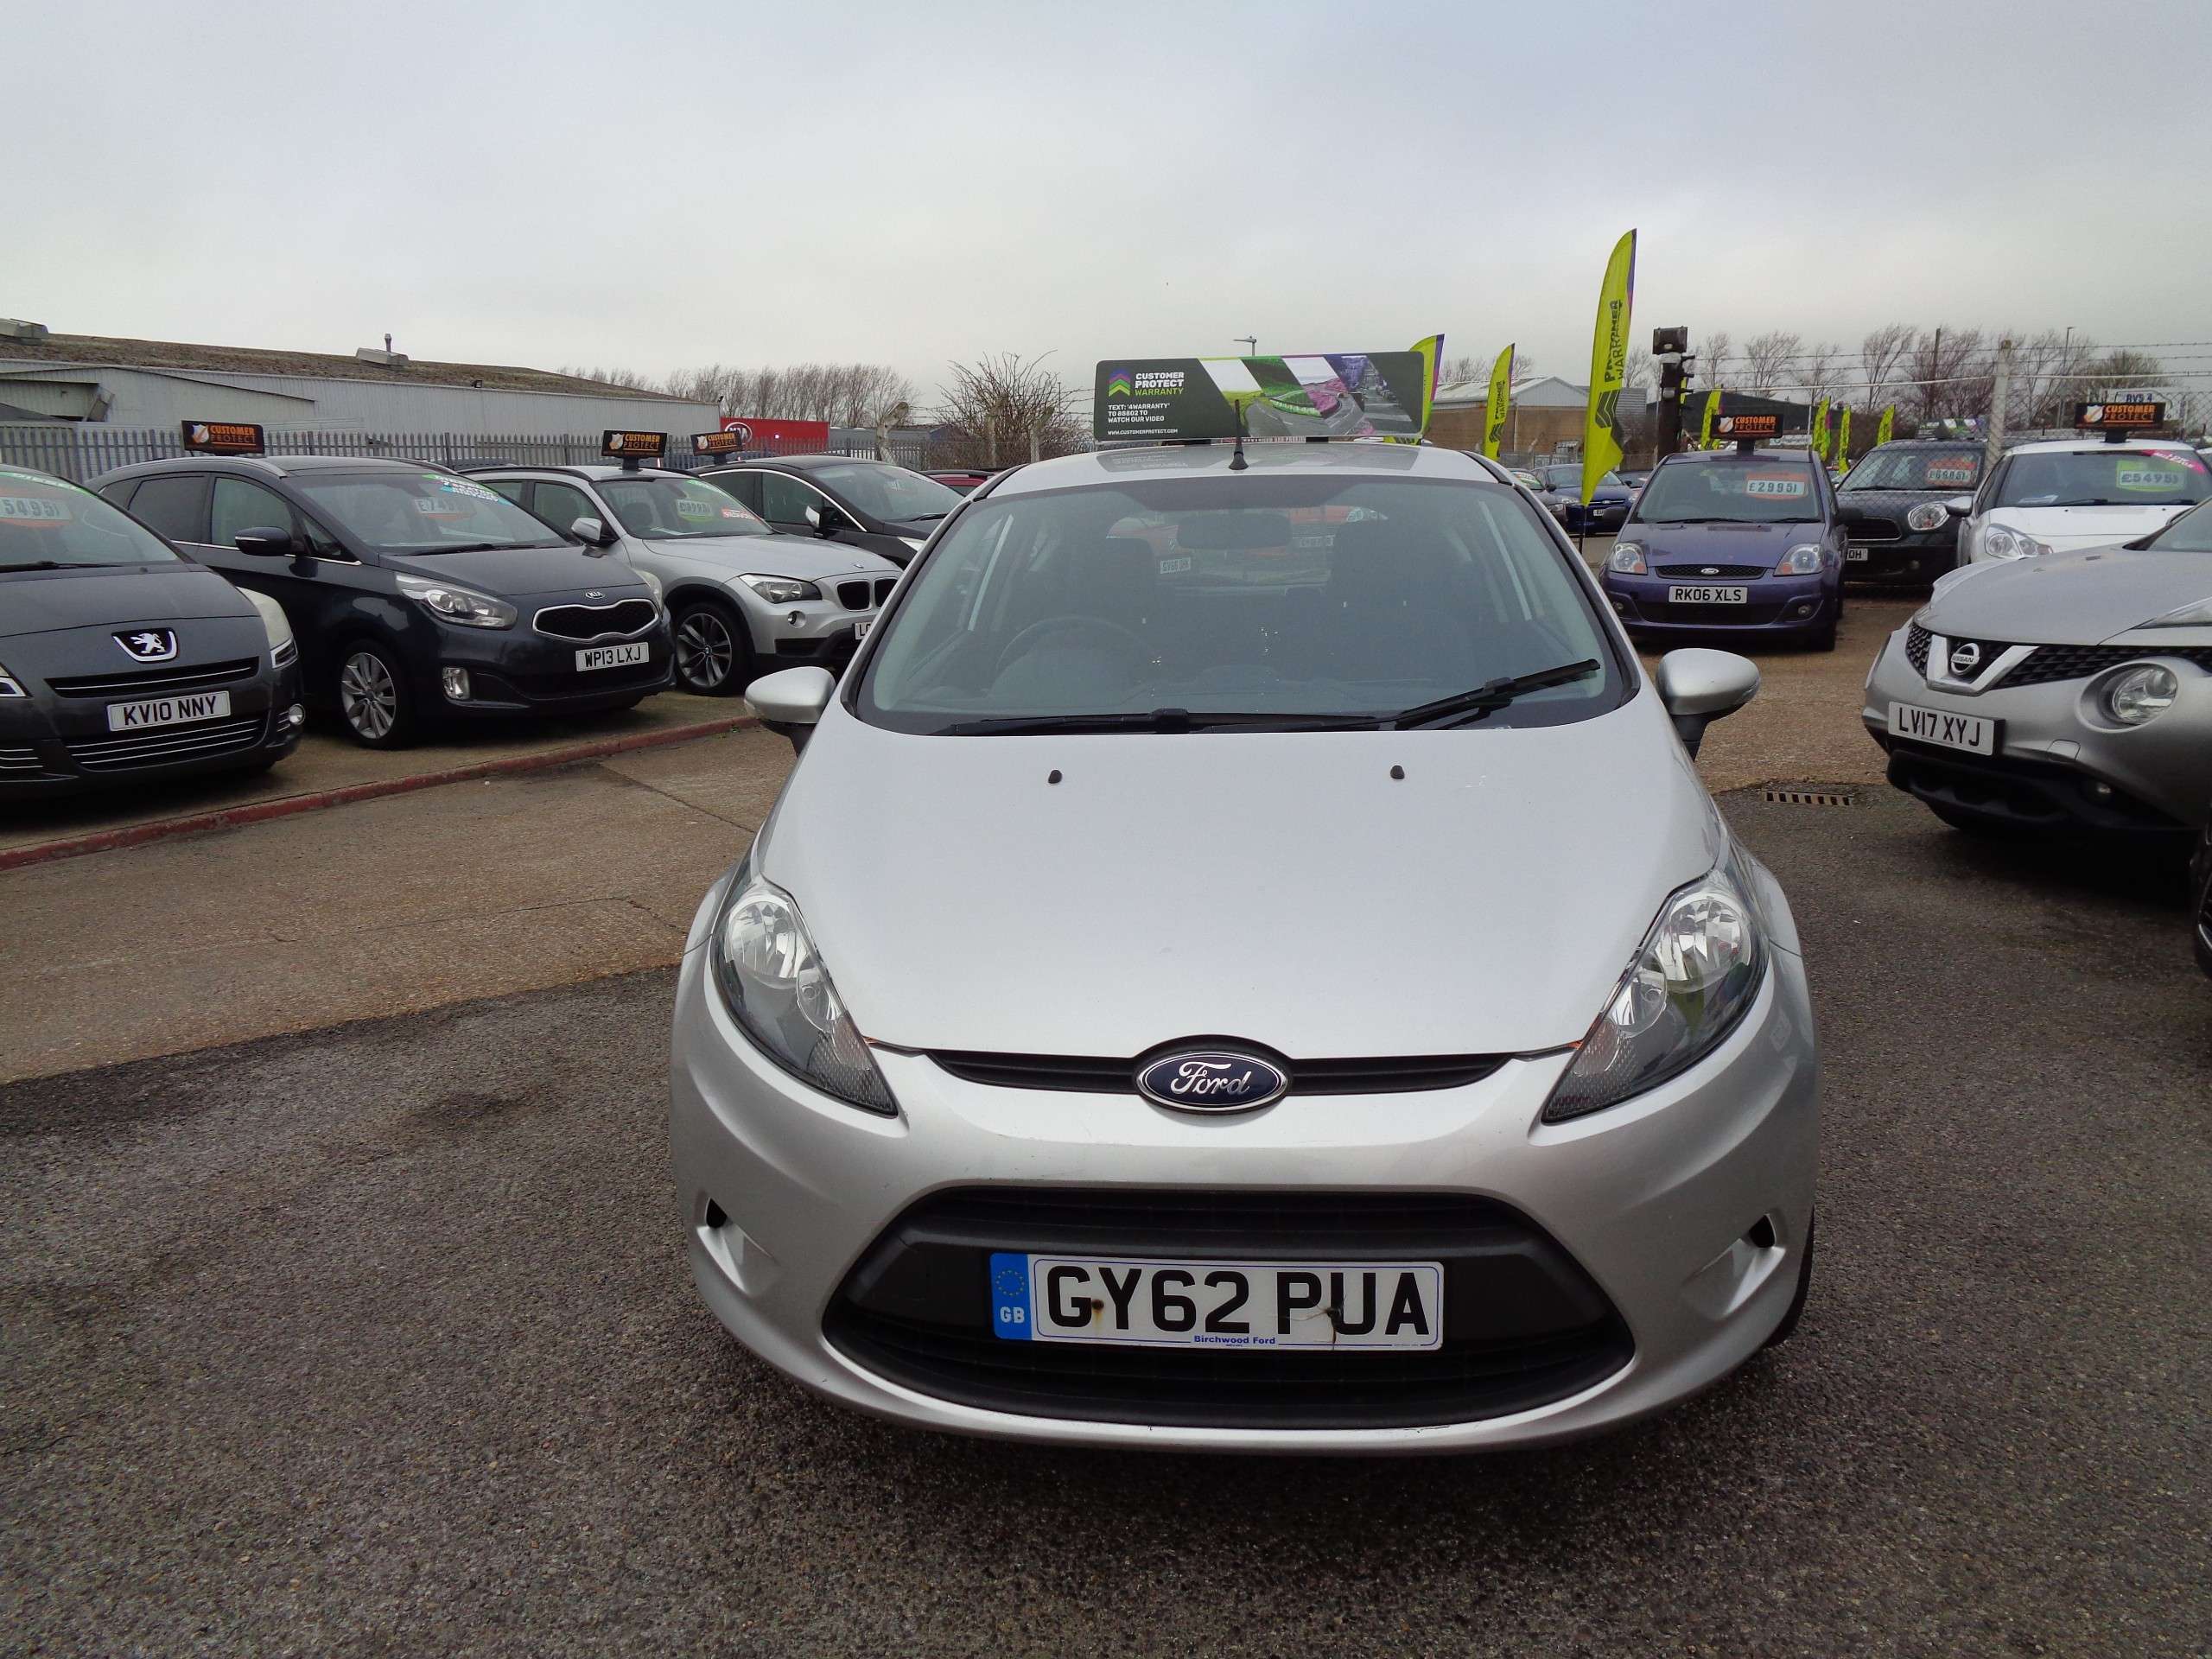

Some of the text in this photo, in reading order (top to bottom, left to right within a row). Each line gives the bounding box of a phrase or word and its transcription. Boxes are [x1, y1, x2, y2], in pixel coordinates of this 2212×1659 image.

[1135, 372, 1185, 380] CUSTOMER
[1135, 379, 1185, 388] PROTECT
[1135, 387, 1184, 396] WARRANTY
[2105, 404, 2156, 413] CUSTOMER
[1735, 416, 1776, 424] CUSTOMER
[209, 424, 255, 435] CUSTOMER
[209, 435, 256, 443] PROTECT
[625, 433, 660, 442] CUSTOMER
[1675, 588, 1741, 601] RK06 XLS
[584, 645, 641, 667] WP13 LXJ
[123, 696, 216, 726] KV10 NNY
[1898, 707, 1980, 747] LV17 XYJ
[1170, 1061, 1252, 1095] Ford
[1046, 1265, 1430, 1335] GY62 PUA
[1000, 1306, 1026, 1324] GB
[1193, 1334, 1249, 1344] Birchwood
